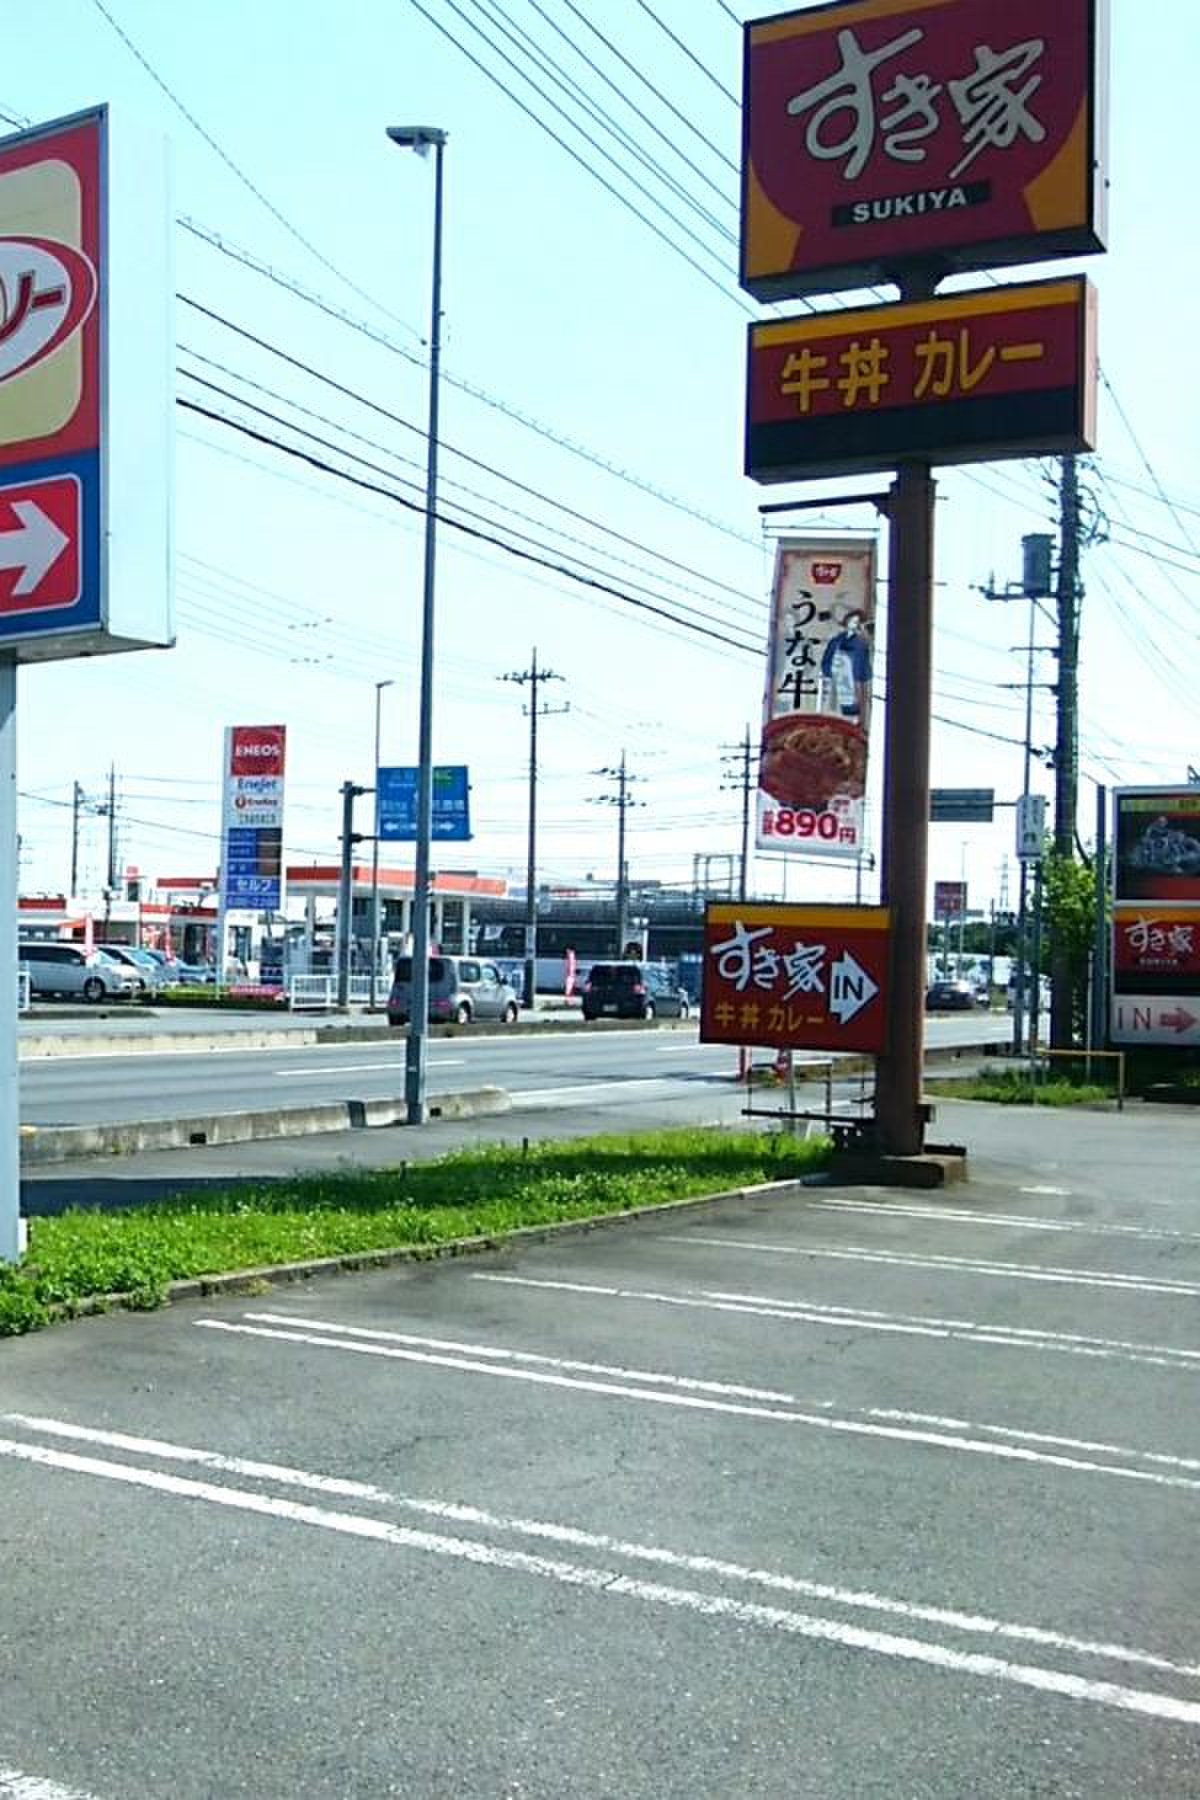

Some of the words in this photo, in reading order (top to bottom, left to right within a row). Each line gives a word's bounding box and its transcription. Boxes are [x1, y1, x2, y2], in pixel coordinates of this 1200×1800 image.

[787, 28, 1046, 180] すき家
[852, 187, 968, 224] SUKIYA
[781, 337, 889, 413] 牛丼
[913, 328, 1045, 399] カレー
[777, 590, 822, 709] うな牛
[235, 744, 281, 757] ENEOS
[775, 809, 856, 844] 890円
[1124, 916, 1194, 957] すき家
[711, 920, 826, 1001] すき家
[833, 975, 864, 1001] IN
[714, 1001, 760, 1029] 牛丼
[767, 1004, 826, 1032] カレー
[1117, 1007, 1152, 1031] IN
